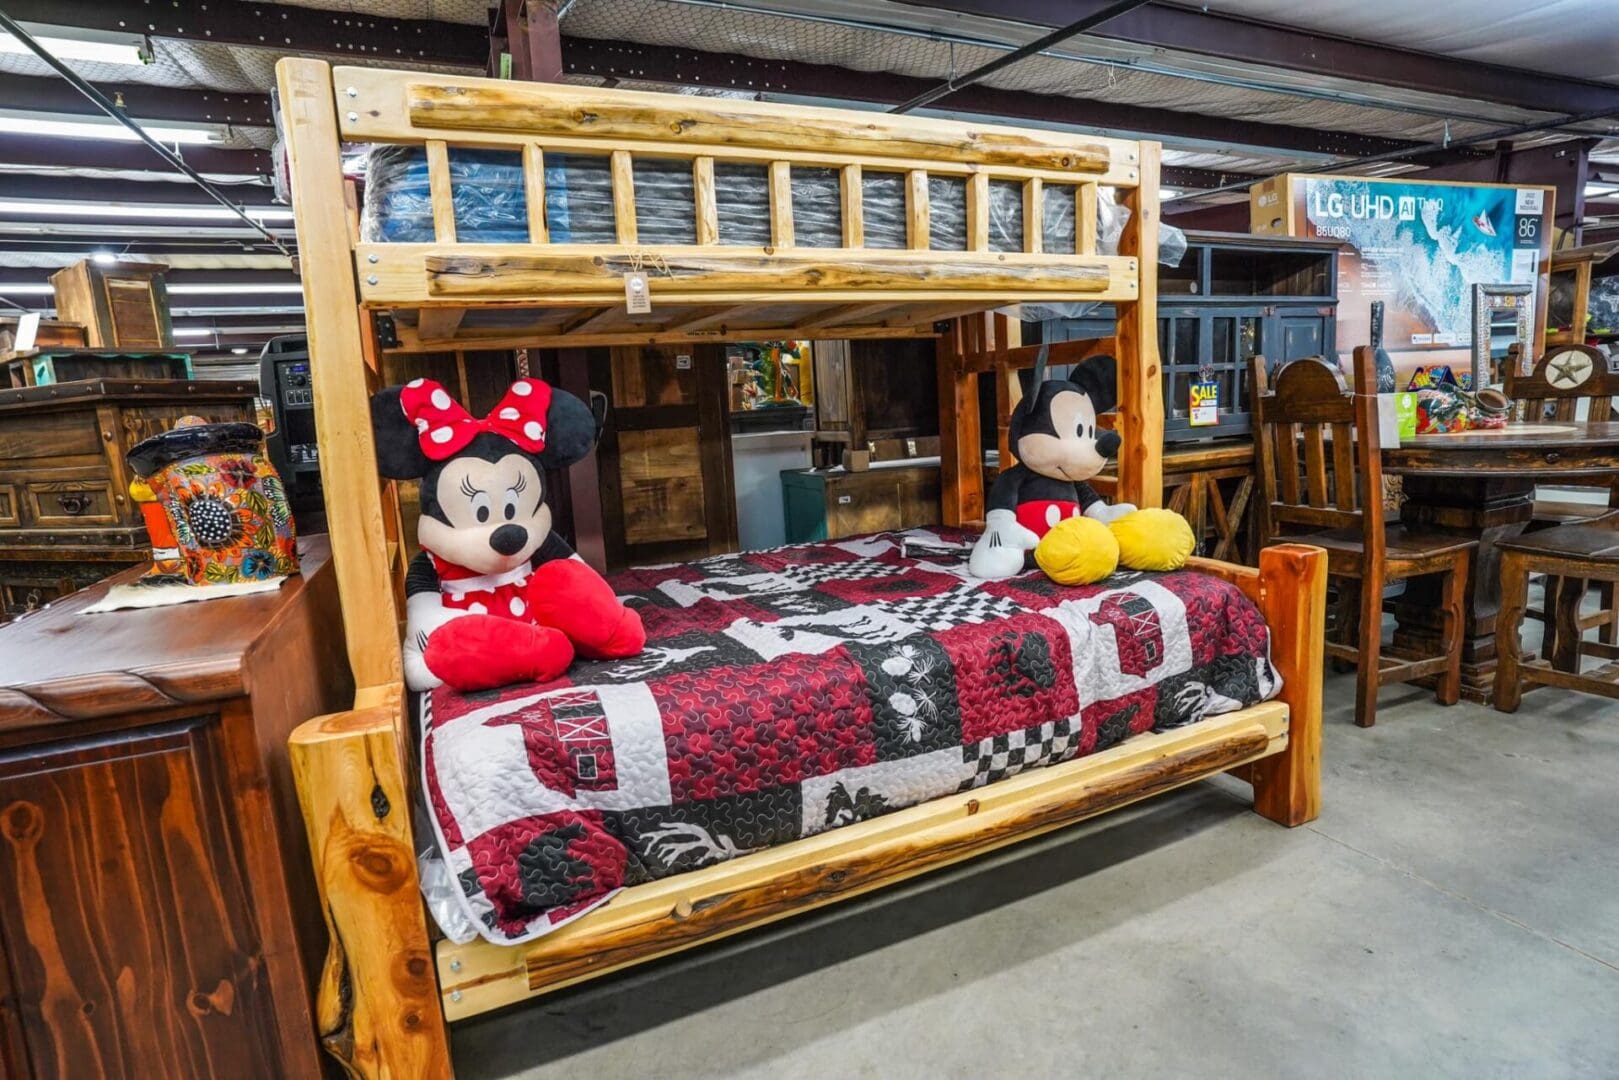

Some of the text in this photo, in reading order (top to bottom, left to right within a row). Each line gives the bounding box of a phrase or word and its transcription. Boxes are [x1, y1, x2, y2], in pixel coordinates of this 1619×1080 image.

[1315, 191, 1344, 218] LG
[1351, 194, 1394, 219] UHD
[1400, 199, 1414, 217] AI
[1191, 384, 1217, 407] SALE
